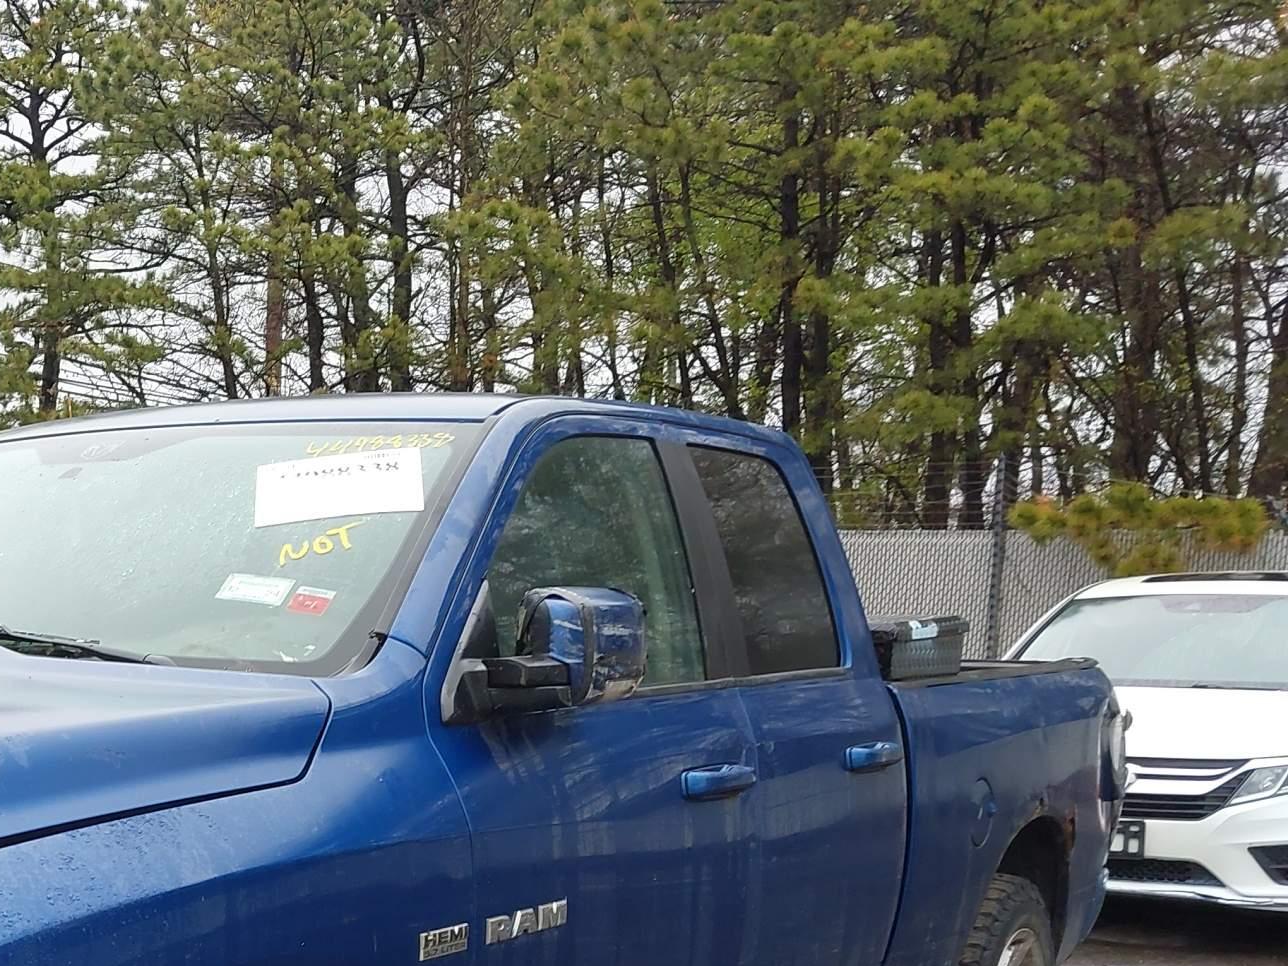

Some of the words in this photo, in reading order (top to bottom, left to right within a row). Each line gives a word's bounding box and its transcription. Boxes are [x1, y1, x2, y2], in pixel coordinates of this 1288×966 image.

[279, 522, 363, 567] NOT
[421, 923, 468, 949] HEMI
[485, 897, 568, 945] RAM
